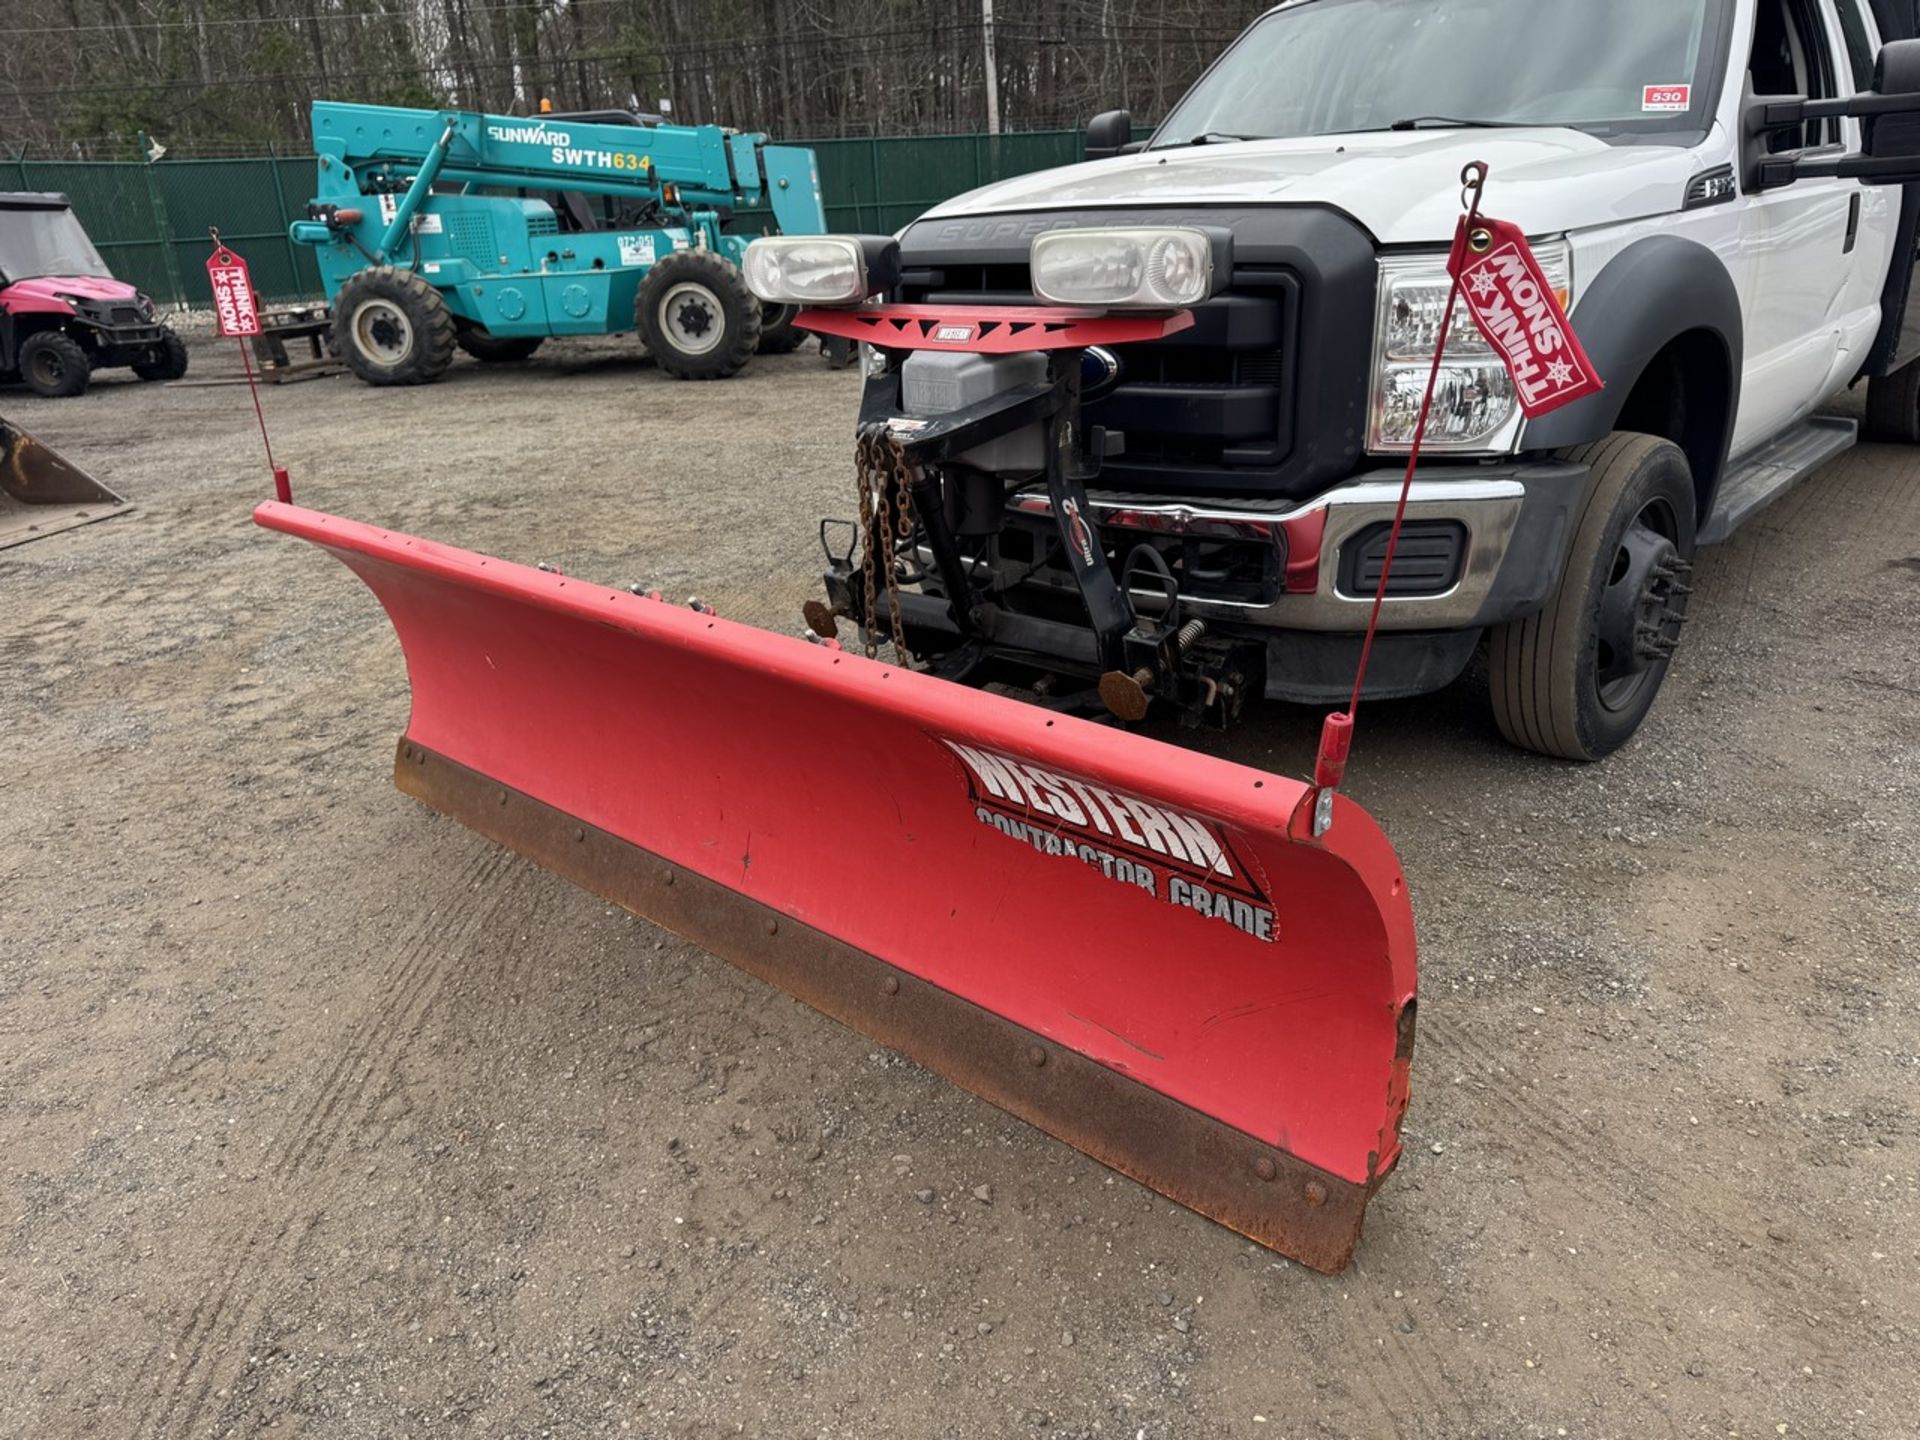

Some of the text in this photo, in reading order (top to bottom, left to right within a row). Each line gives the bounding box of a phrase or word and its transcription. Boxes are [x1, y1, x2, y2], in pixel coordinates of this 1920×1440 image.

[1652, 92, 1682, 102] 530
[488, 123, 570, 147] SUNWARD
[552, 147, 649, 170] SWTH634
[217, 285, 241, 331] SNOW
[229, 268, 253, 318] THINK
[1491, 254, 1562, 355] SNOW
[1478, 291, 1549, 401] THINK
[942, 738, 1234, 878] WESTERN
[976, 806, 1274, 943] CONTRACTOR GRADE
